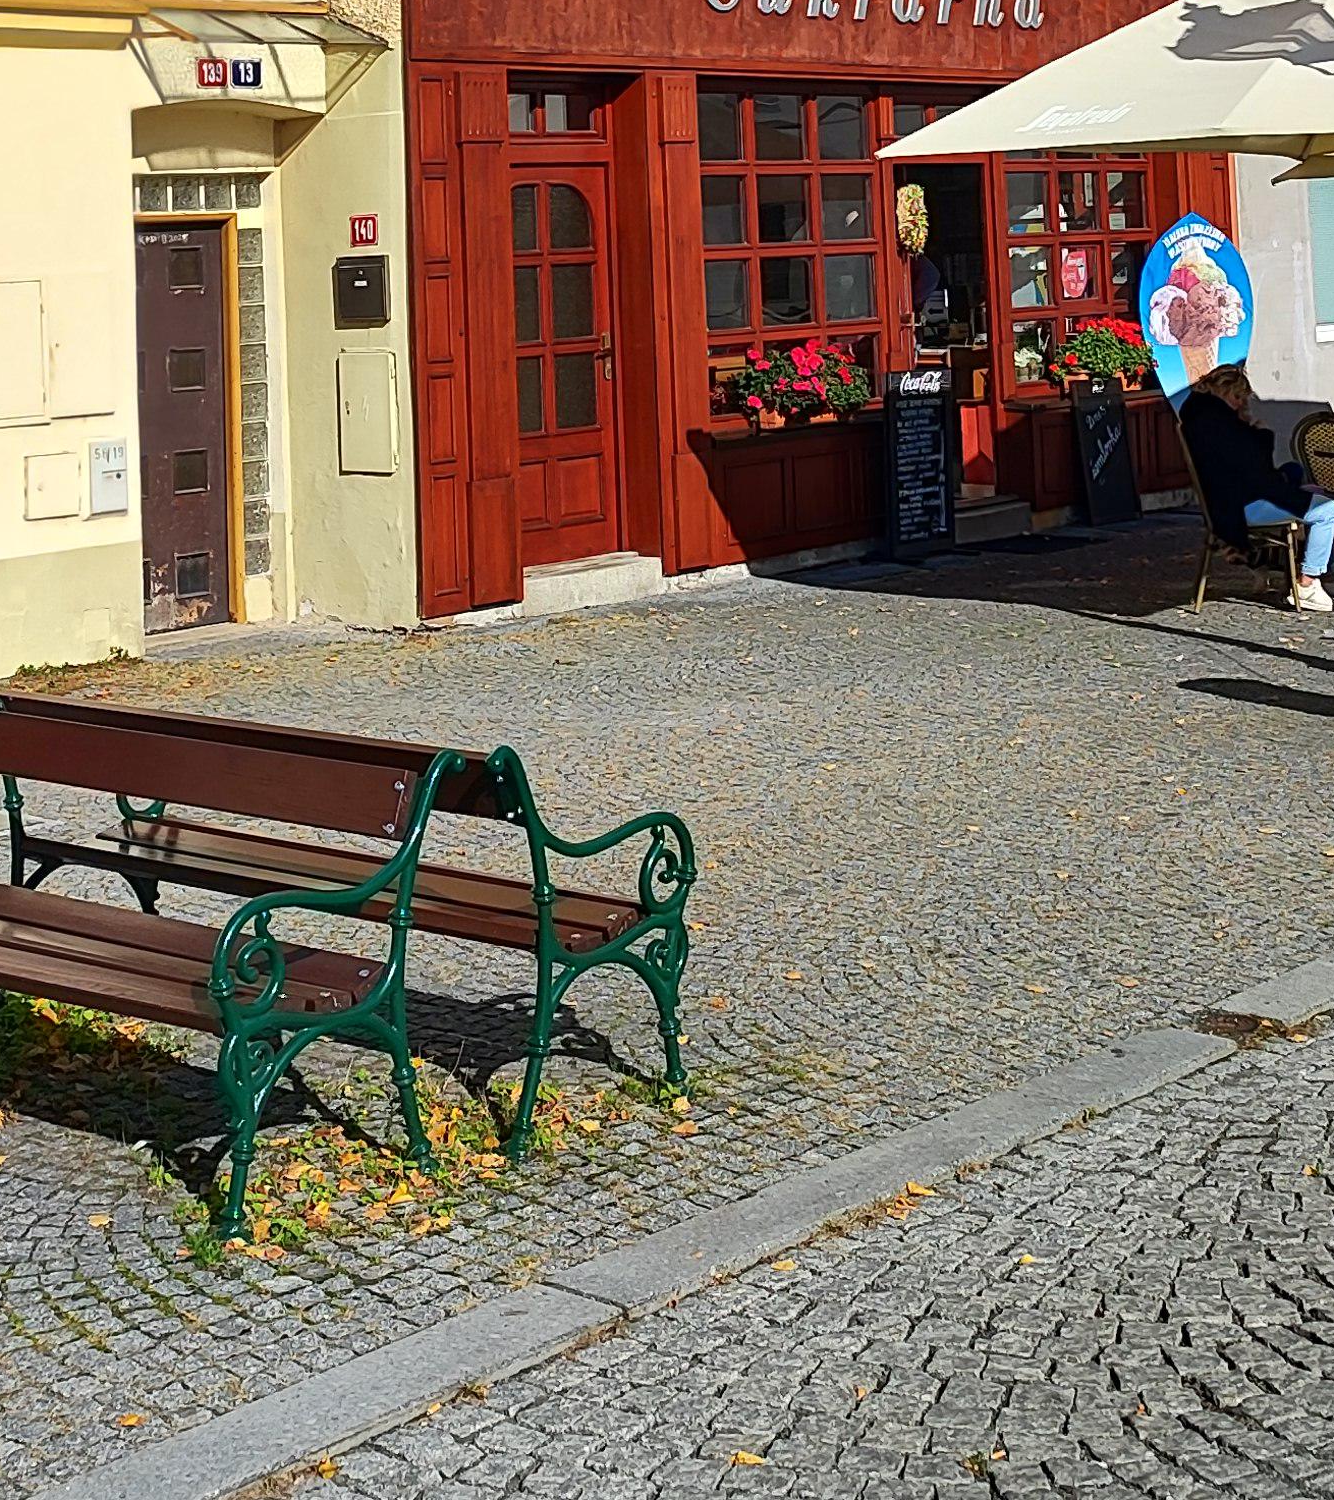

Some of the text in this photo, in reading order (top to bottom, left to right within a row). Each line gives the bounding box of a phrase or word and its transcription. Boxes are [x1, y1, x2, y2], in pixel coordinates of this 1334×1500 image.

[202, 62, 223, 84] 139
[239, 62, 254, 83] 13
[354, 219, 374, 242] 140
